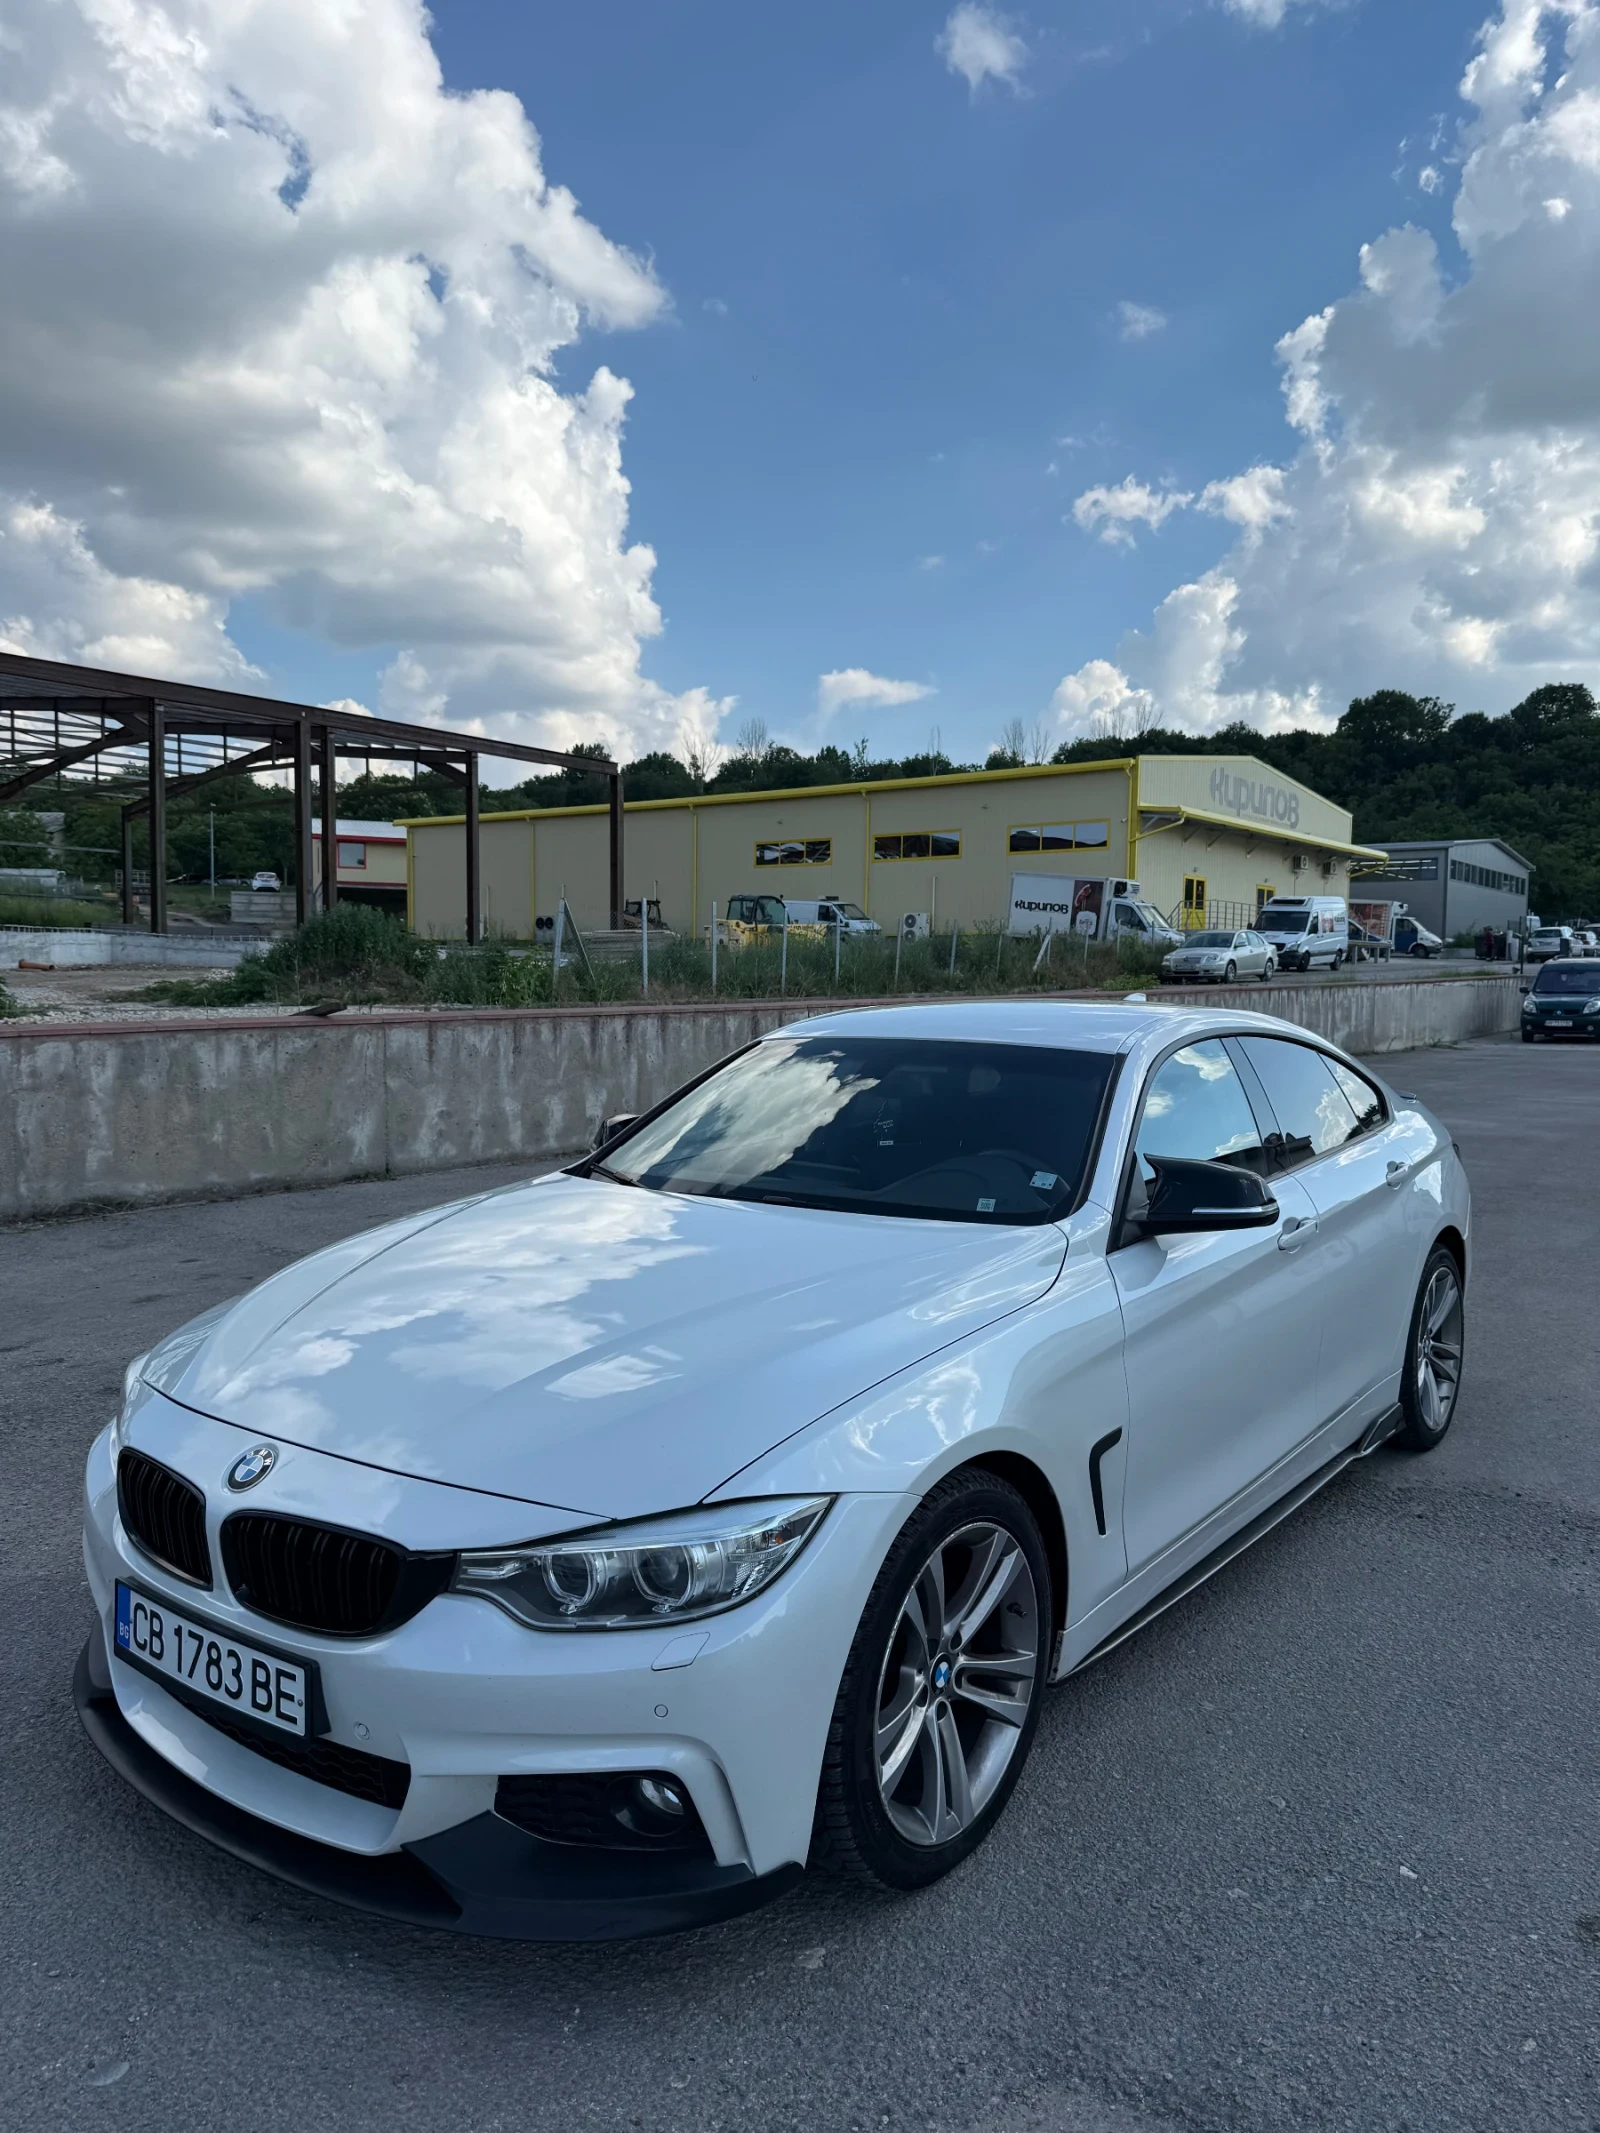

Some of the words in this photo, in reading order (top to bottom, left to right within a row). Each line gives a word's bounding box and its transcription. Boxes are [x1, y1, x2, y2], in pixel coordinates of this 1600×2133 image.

[119, 1621, 130, 1639] BG
[133, 1602, 165, 1661] CB
[174, 1624, 243, 1700] 1783
[251, 1657, 298, 1725] BE
